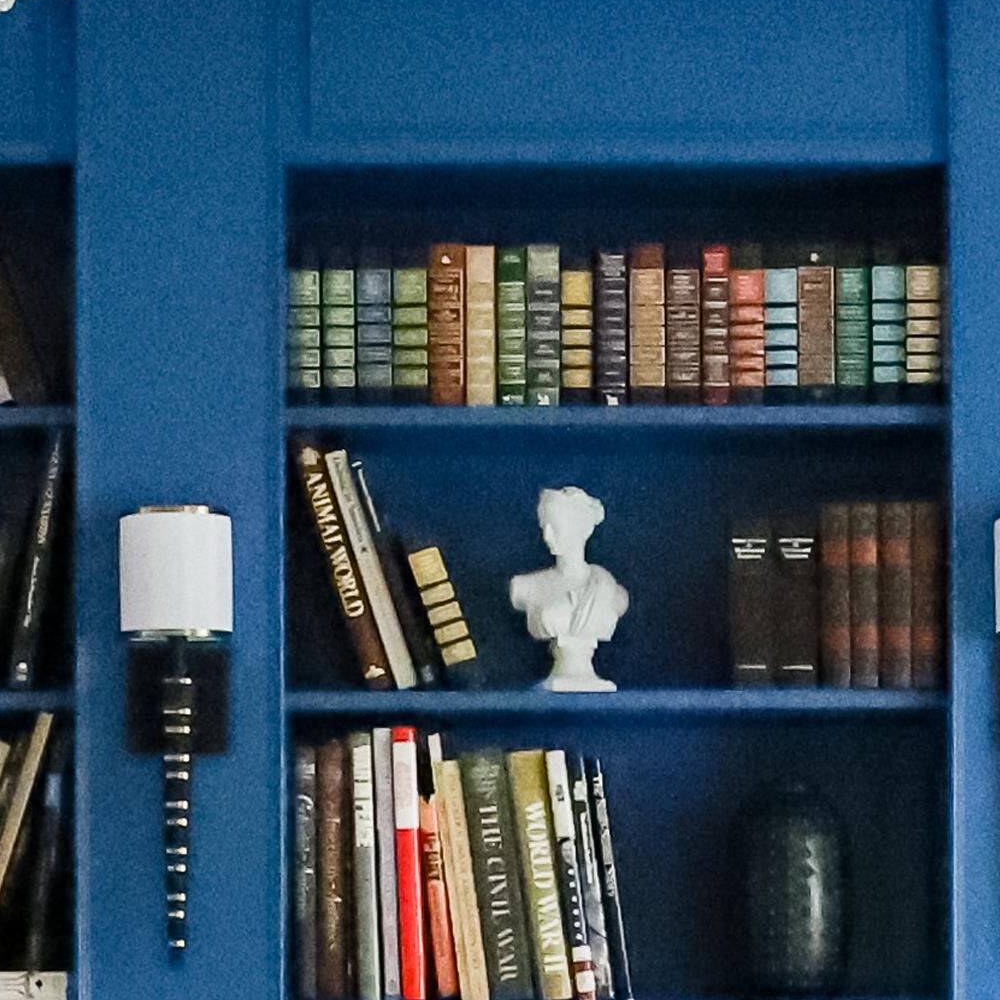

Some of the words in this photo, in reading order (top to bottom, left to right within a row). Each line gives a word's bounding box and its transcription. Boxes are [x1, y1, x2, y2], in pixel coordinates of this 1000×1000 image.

[303, 471, 347, 551] ANIMAL
[329, 546, 365, 617] WORLD
[478, 804, 503, 850] THE
[524, 800, 556, 889] WORLD
[486, 856, 511, 923] CIVIL
[537, 892, 563, 949] WAR
[495, 927, 518, 982] WAR
[543, 954, 566, 974] II
